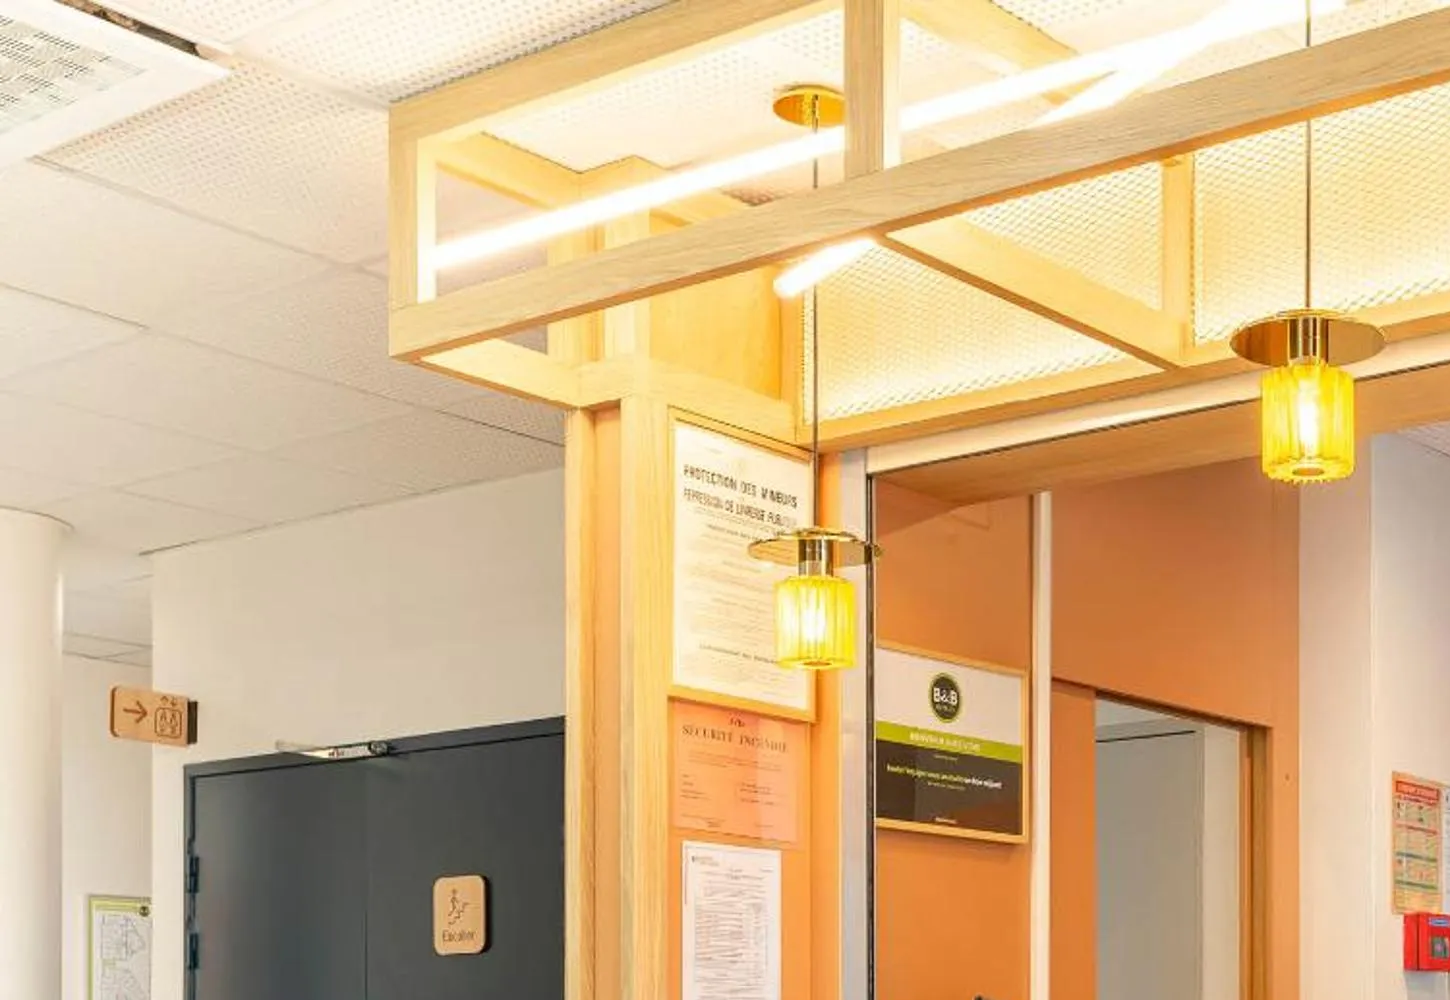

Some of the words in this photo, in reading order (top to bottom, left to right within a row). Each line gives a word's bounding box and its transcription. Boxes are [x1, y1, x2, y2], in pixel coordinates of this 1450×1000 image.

[683, 464, 737, 491] PROTECTION
[740, 481, 757, 497] DES
[933, 687, 958, 705] B&B
[442, 929, 478, 942] Escalier
